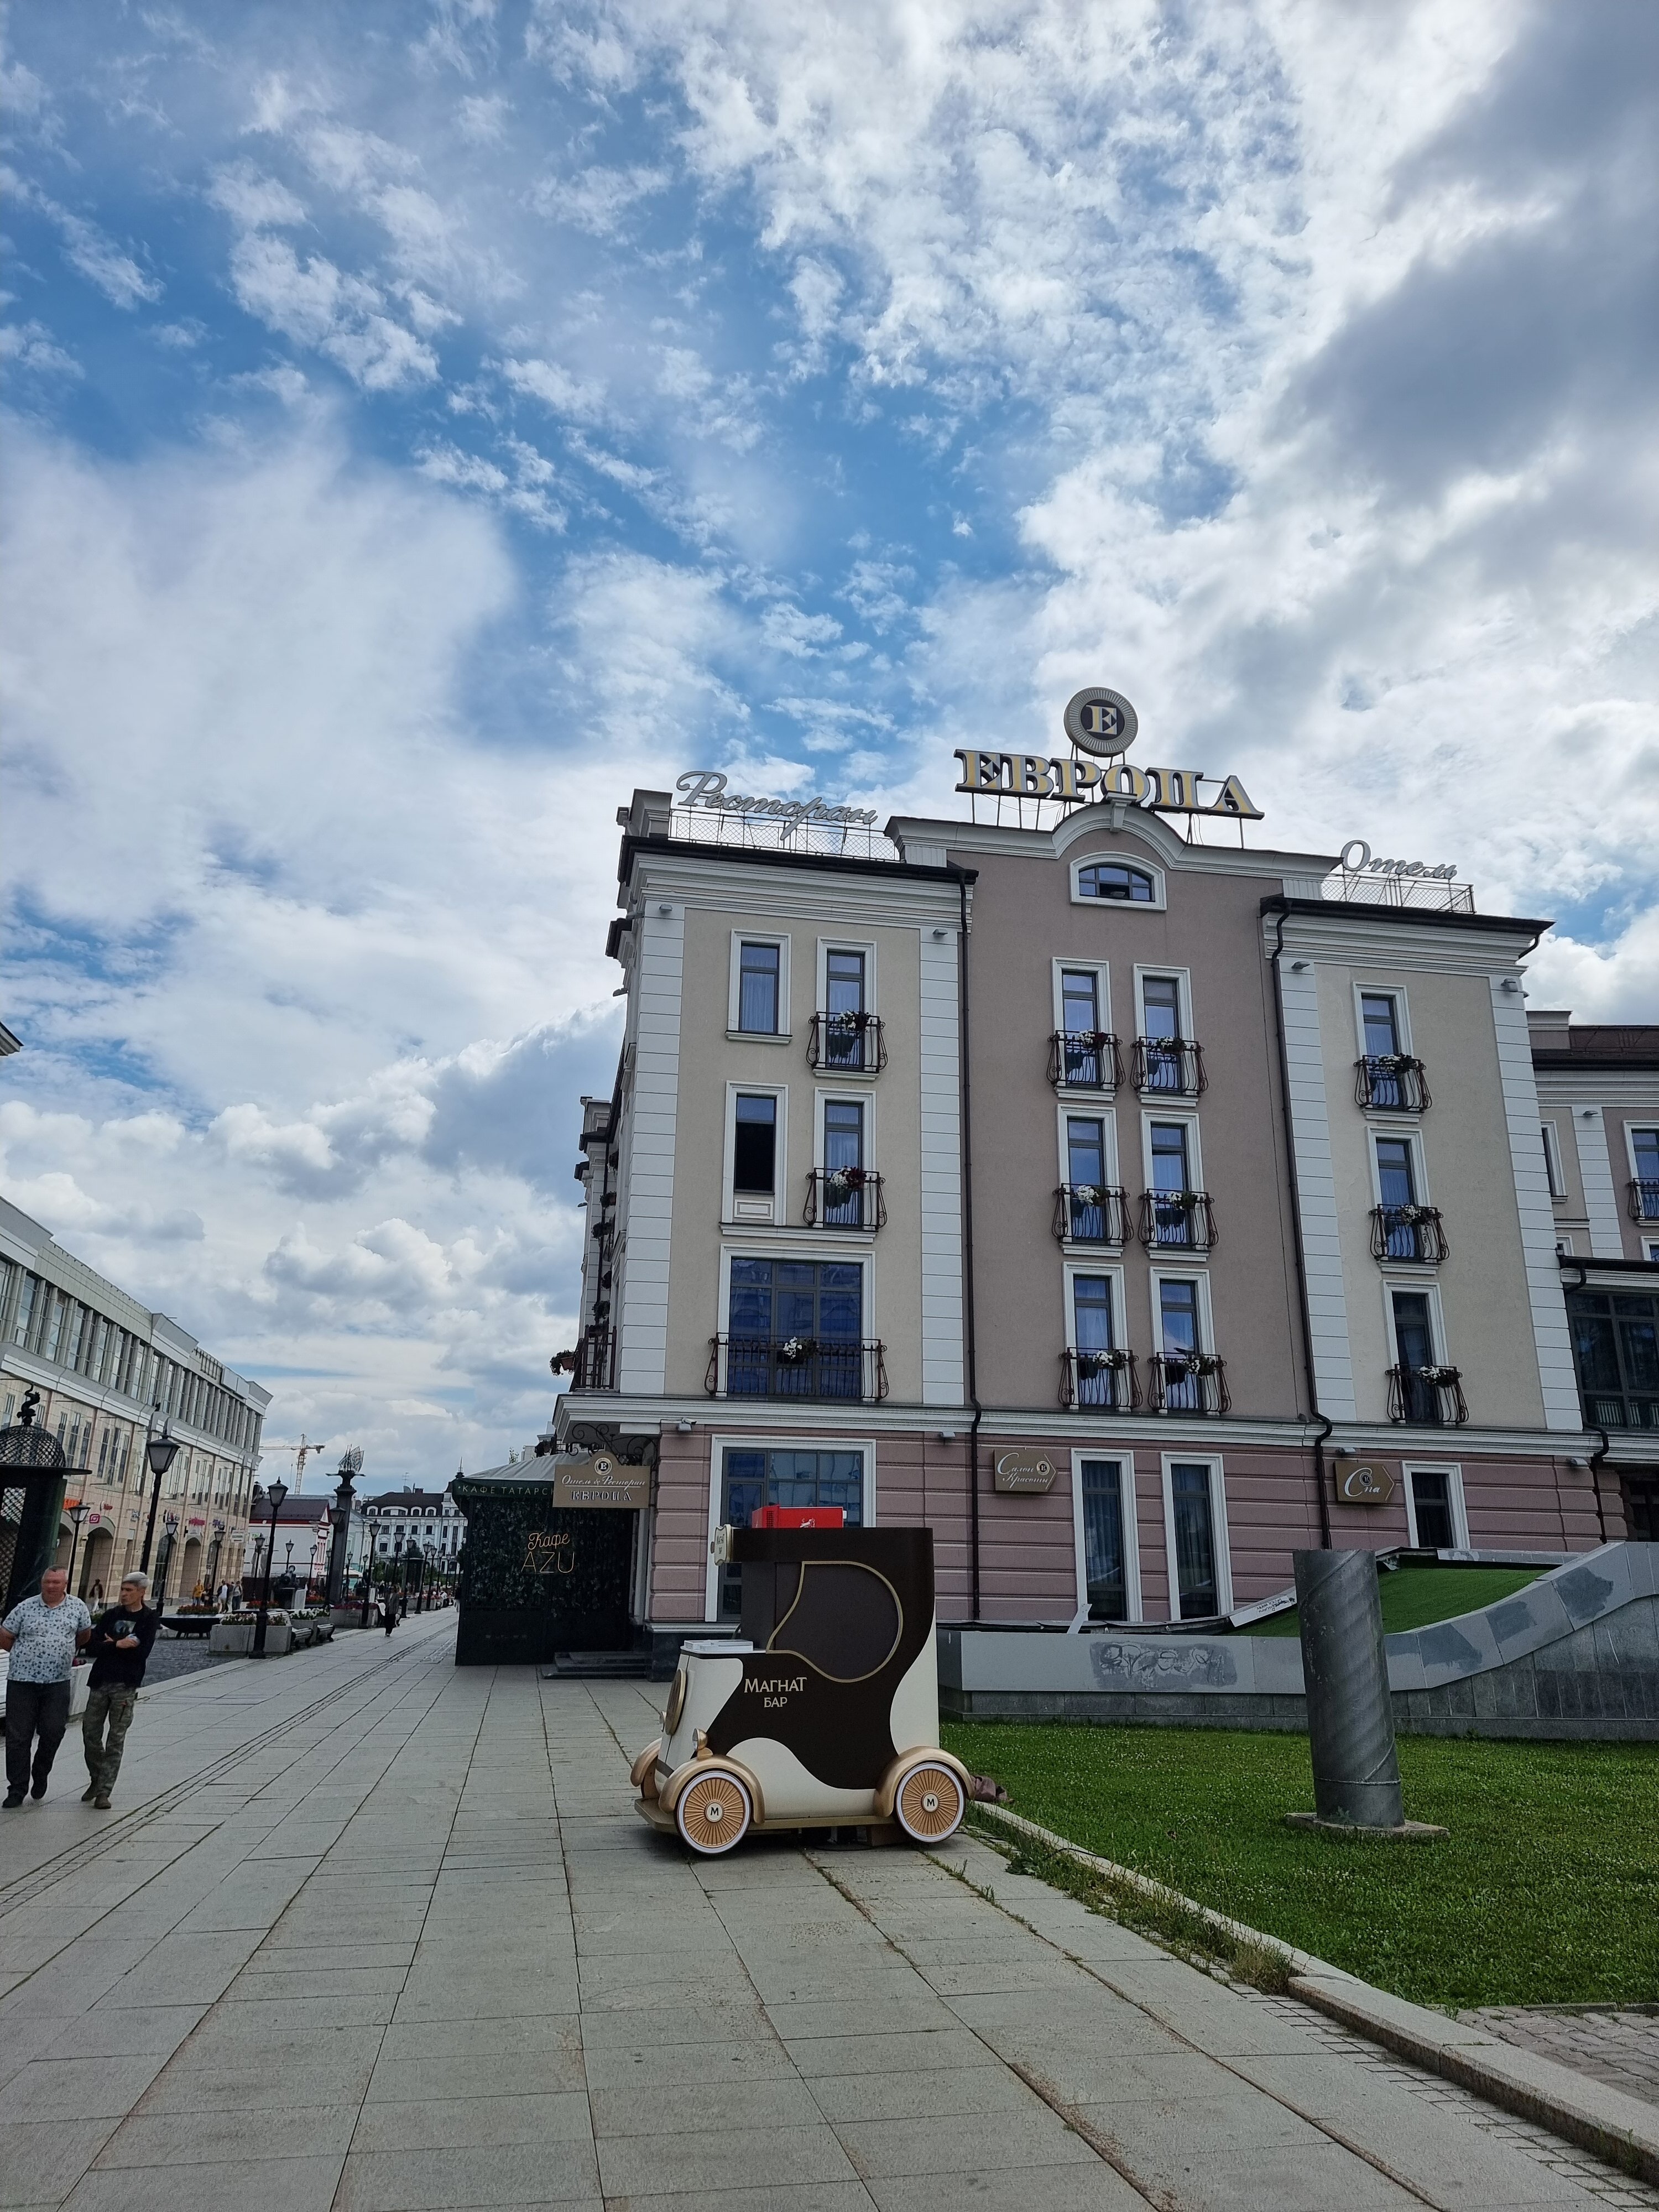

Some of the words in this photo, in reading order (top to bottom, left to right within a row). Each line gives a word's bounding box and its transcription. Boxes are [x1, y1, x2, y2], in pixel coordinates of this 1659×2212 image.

[953, 749, 1265, 820] ЕВРОПА
[676, 771, 878, 841] Ресторан
[1340, 839, 1458, 879] Отель
[997, 1452, 1034, 1475] Салон
[462, 1485, 495, 1494] КАФЕ
[561, 1475, 591, 1485] Отель
[602, 1475, 646, 1491] Ресторан
[1002, 1472, 1048, 1489] Красоты
[1344, 1467, 1381, 1497] Спа
[570, 1490, 632, 1501] ЕВРОПА
[528, 1531, 570, 1550] Кафе
[521, 1551, 575, 1573] AZU
[744, 1677, 807, 1693] МАГНАТ
[764, 1697, 788, 1708] БАР
